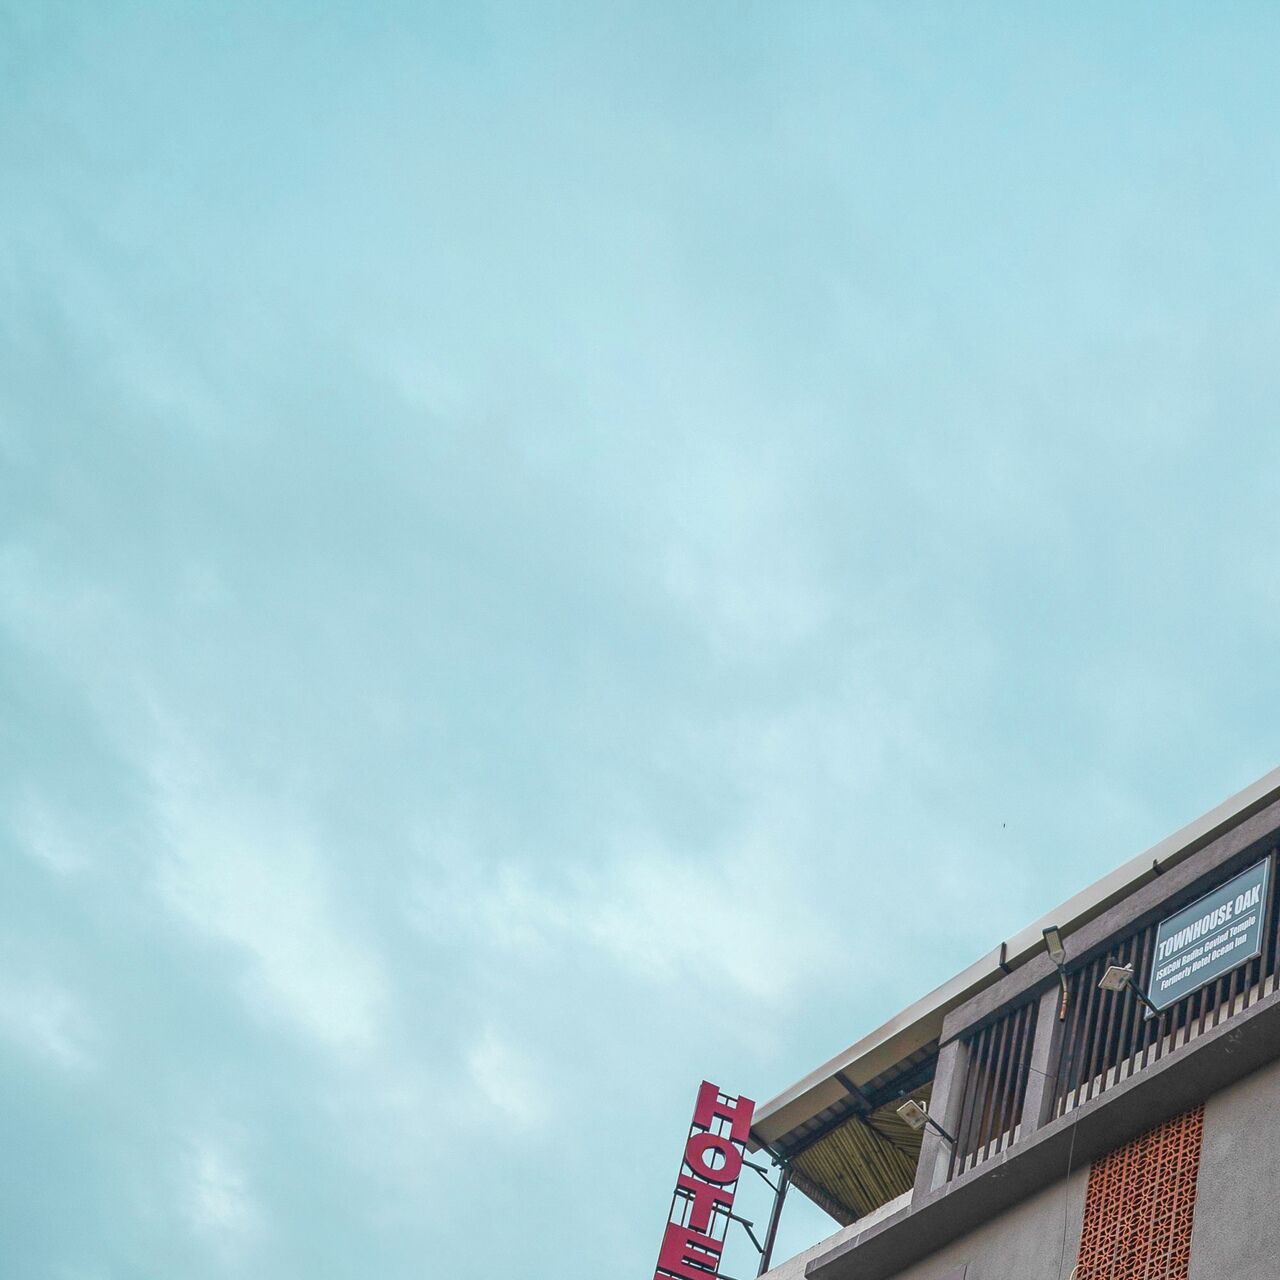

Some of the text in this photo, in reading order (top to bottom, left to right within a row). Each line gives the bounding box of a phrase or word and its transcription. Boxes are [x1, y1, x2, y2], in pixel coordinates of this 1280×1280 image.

[1156, 916, 1256, 981] ISKCON Radha Govind Temple
[1159, 884, 1261, 961] TOWNHOUSE OAK
[1160, 933, 1247, 991] Formerly Hotel Ocean Inn
